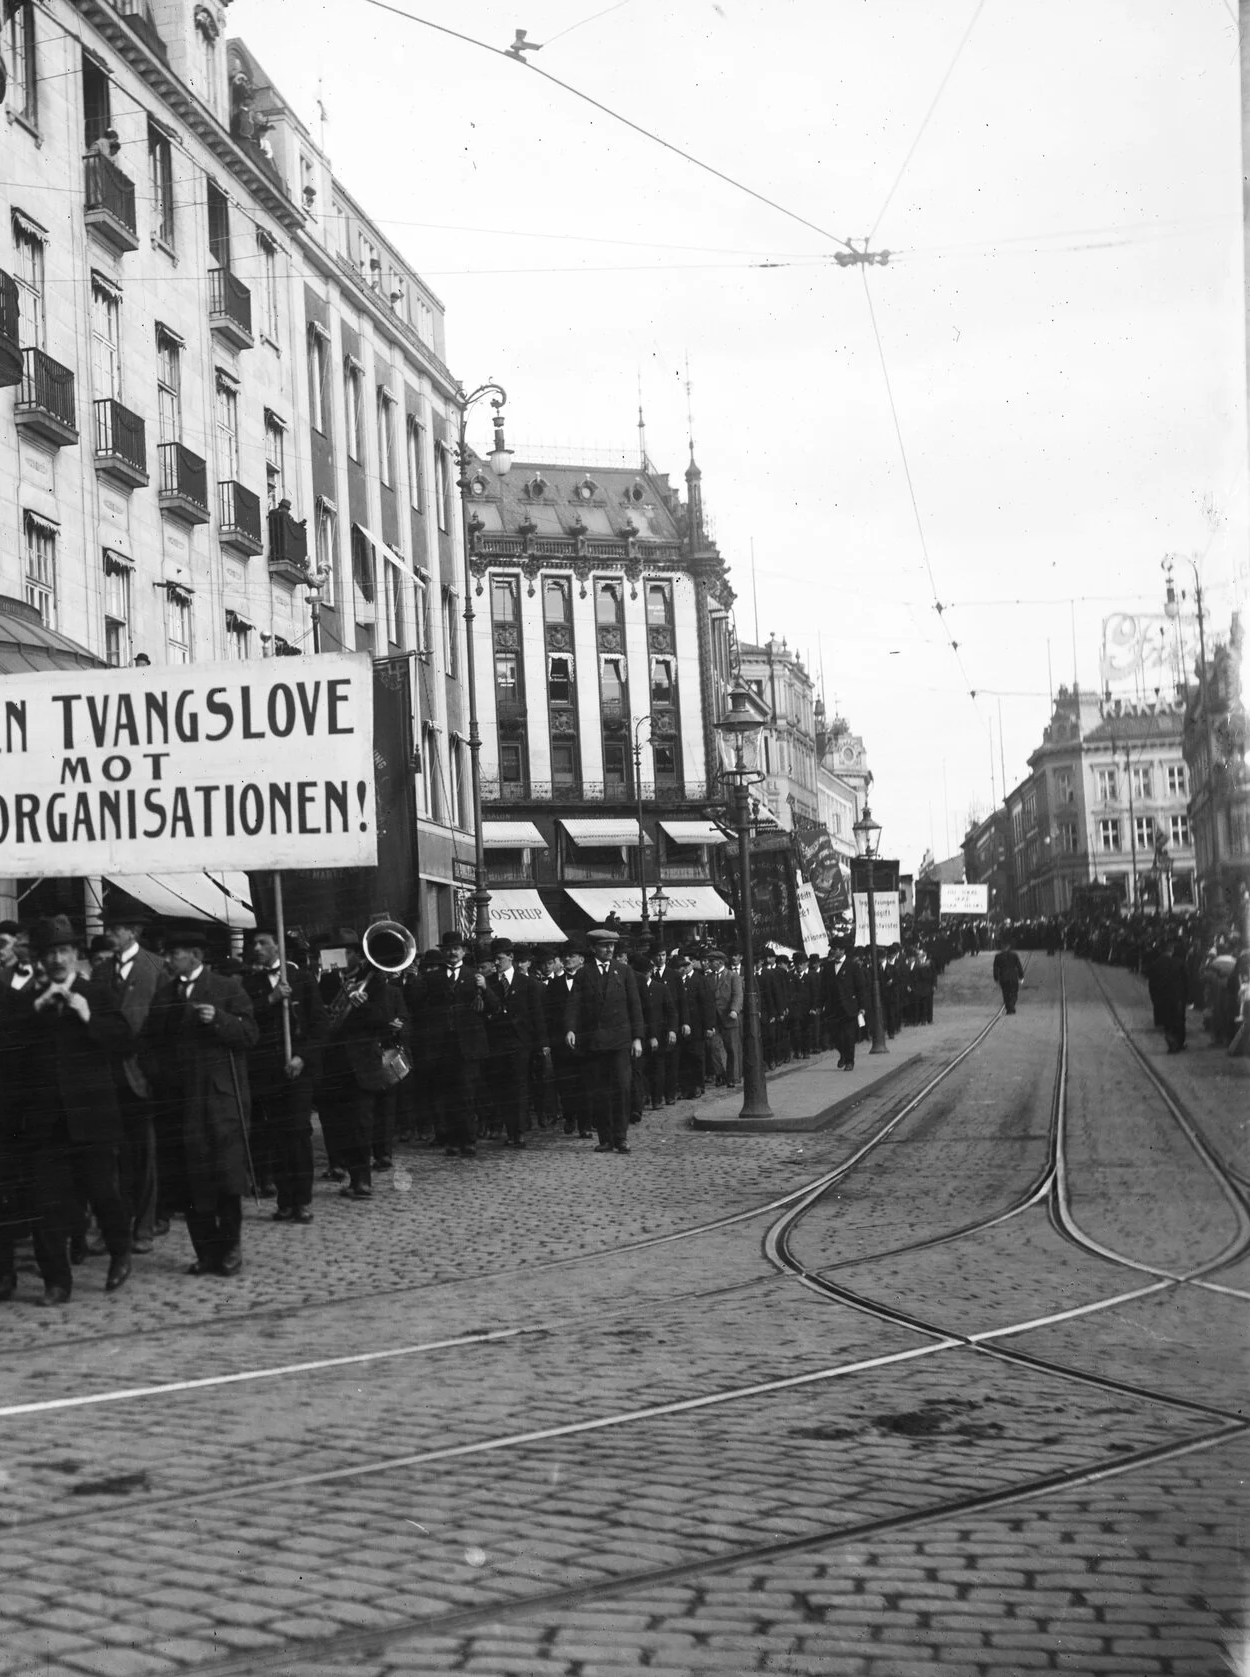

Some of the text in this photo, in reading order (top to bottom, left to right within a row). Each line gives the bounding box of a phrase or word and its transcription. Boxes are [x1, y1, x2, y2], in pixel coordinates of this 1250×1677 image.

[52, 678, 355, 750] TVANGSLOVE
[60, 752, 171, 785] MOT
[490, 908, 542, 920] OSTRUP
